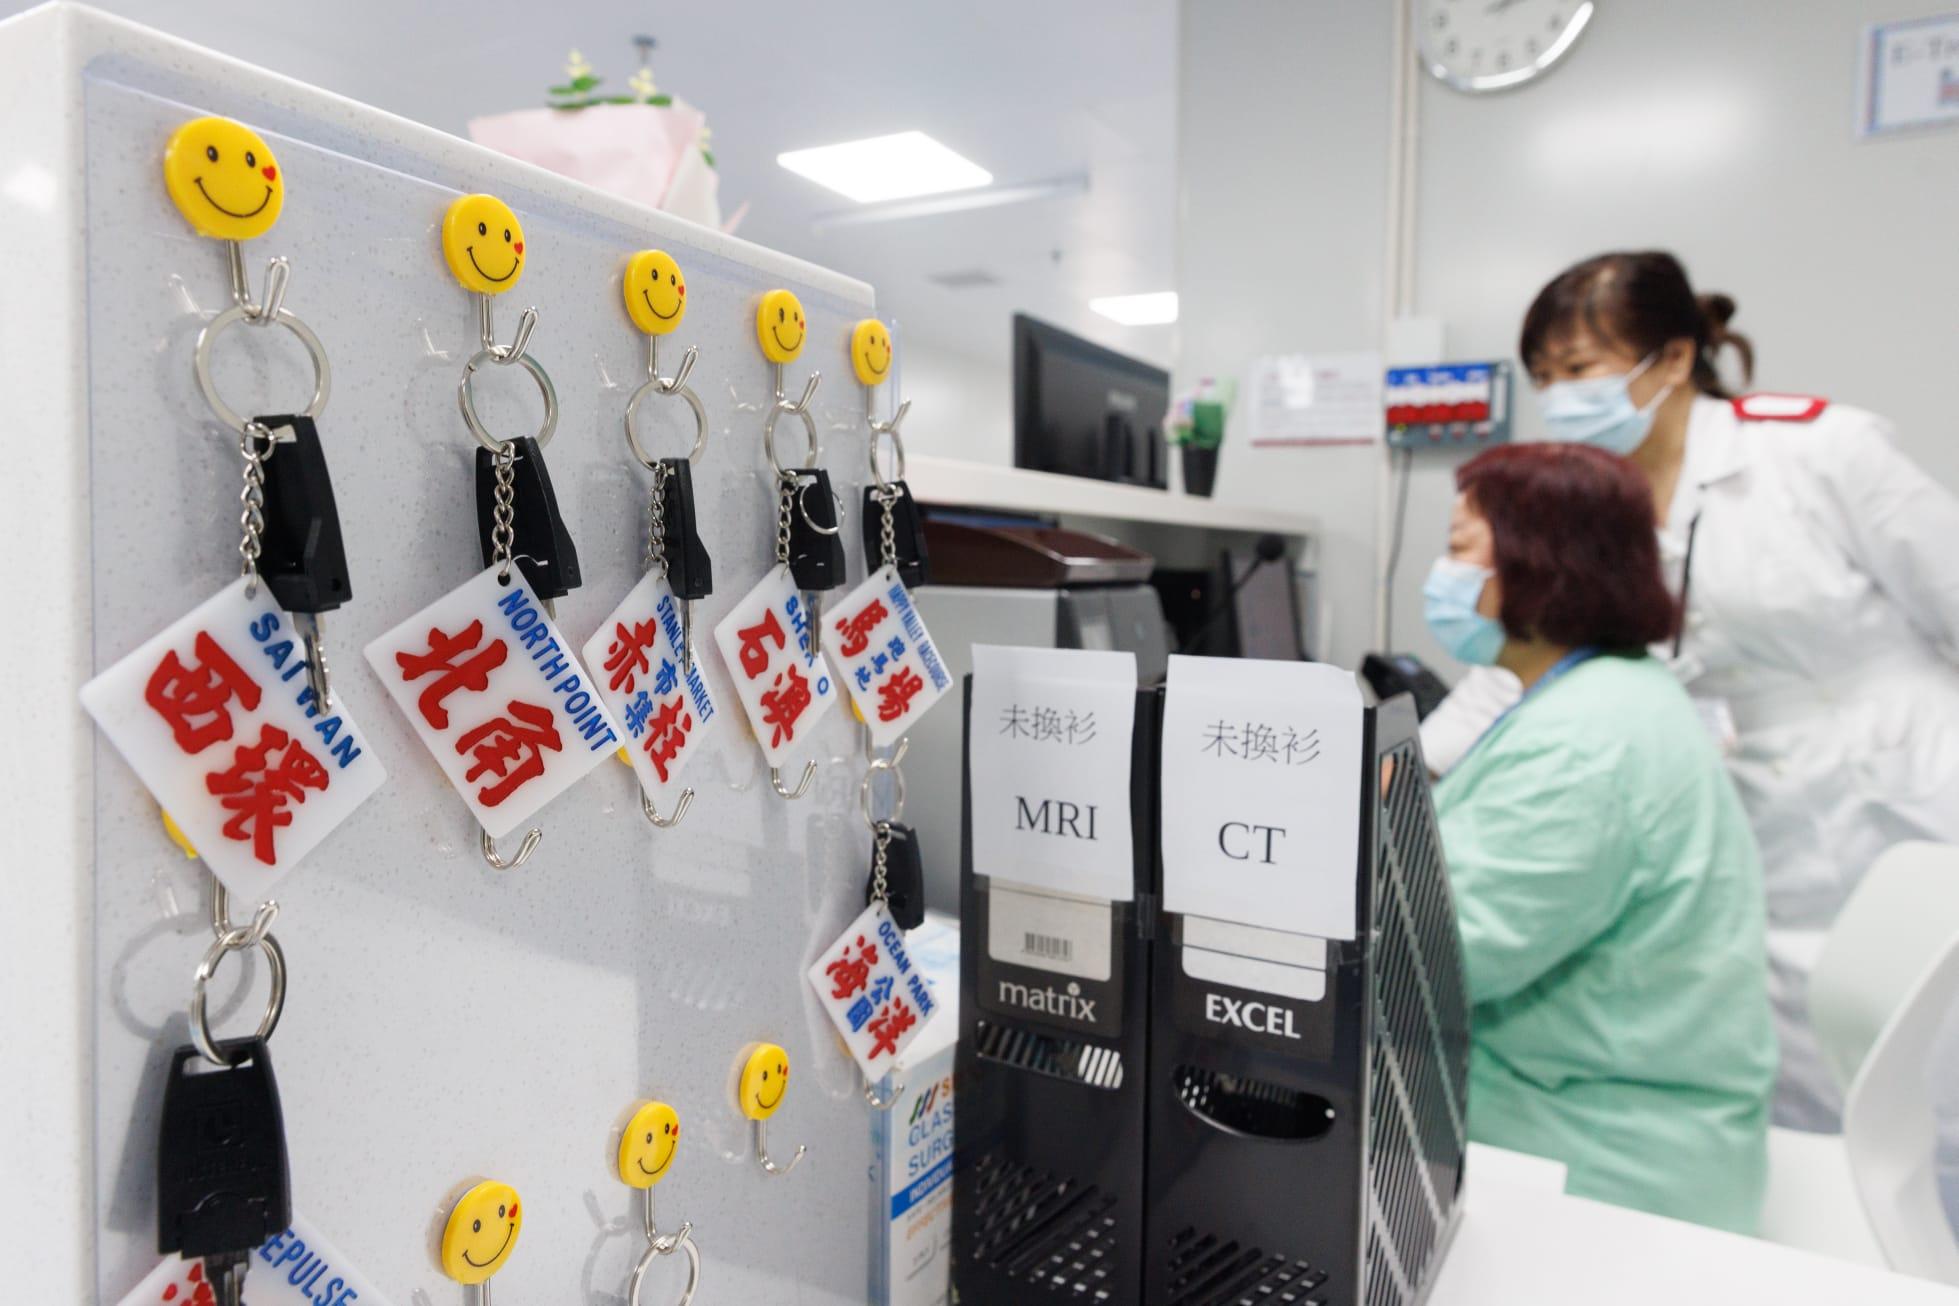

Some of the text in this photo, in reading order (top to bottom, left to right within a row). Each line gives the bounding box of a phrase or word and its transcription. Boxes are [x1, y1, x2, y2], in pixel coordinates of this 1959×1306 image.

[249, 612, 308, 682] SAI
[656, 594, 685, 664] STANLE
[902, 609, 924, 642] VALLEY
[497, 588, 618, 752] NORTH POINT
[603, 618, 692, 783] 赤柱
[736, 608, 812, 748] 石澳
[817, 675, 830, 696] O
[143, 631, 329, 866] 西環
[395, 619, 562, 808] 北角
[999, 703, 1098, 746] 未換衫
[1200, 718, 1321, 766] 未換衫
[1015, 795, 1099, 841] MRI
[1217, 821, 1287, 865] CT
[826, 935, 916, 1060] 海洋
[877, 921, 933, 1017] OCEAN PARK
[998, 980, 1097, 1023] matrix
[1205, 994, 1302, 1039] EXCEL
[908, 1130, 954, 1177] SURG
[258, 1227, 359, 1306] EPULSE
